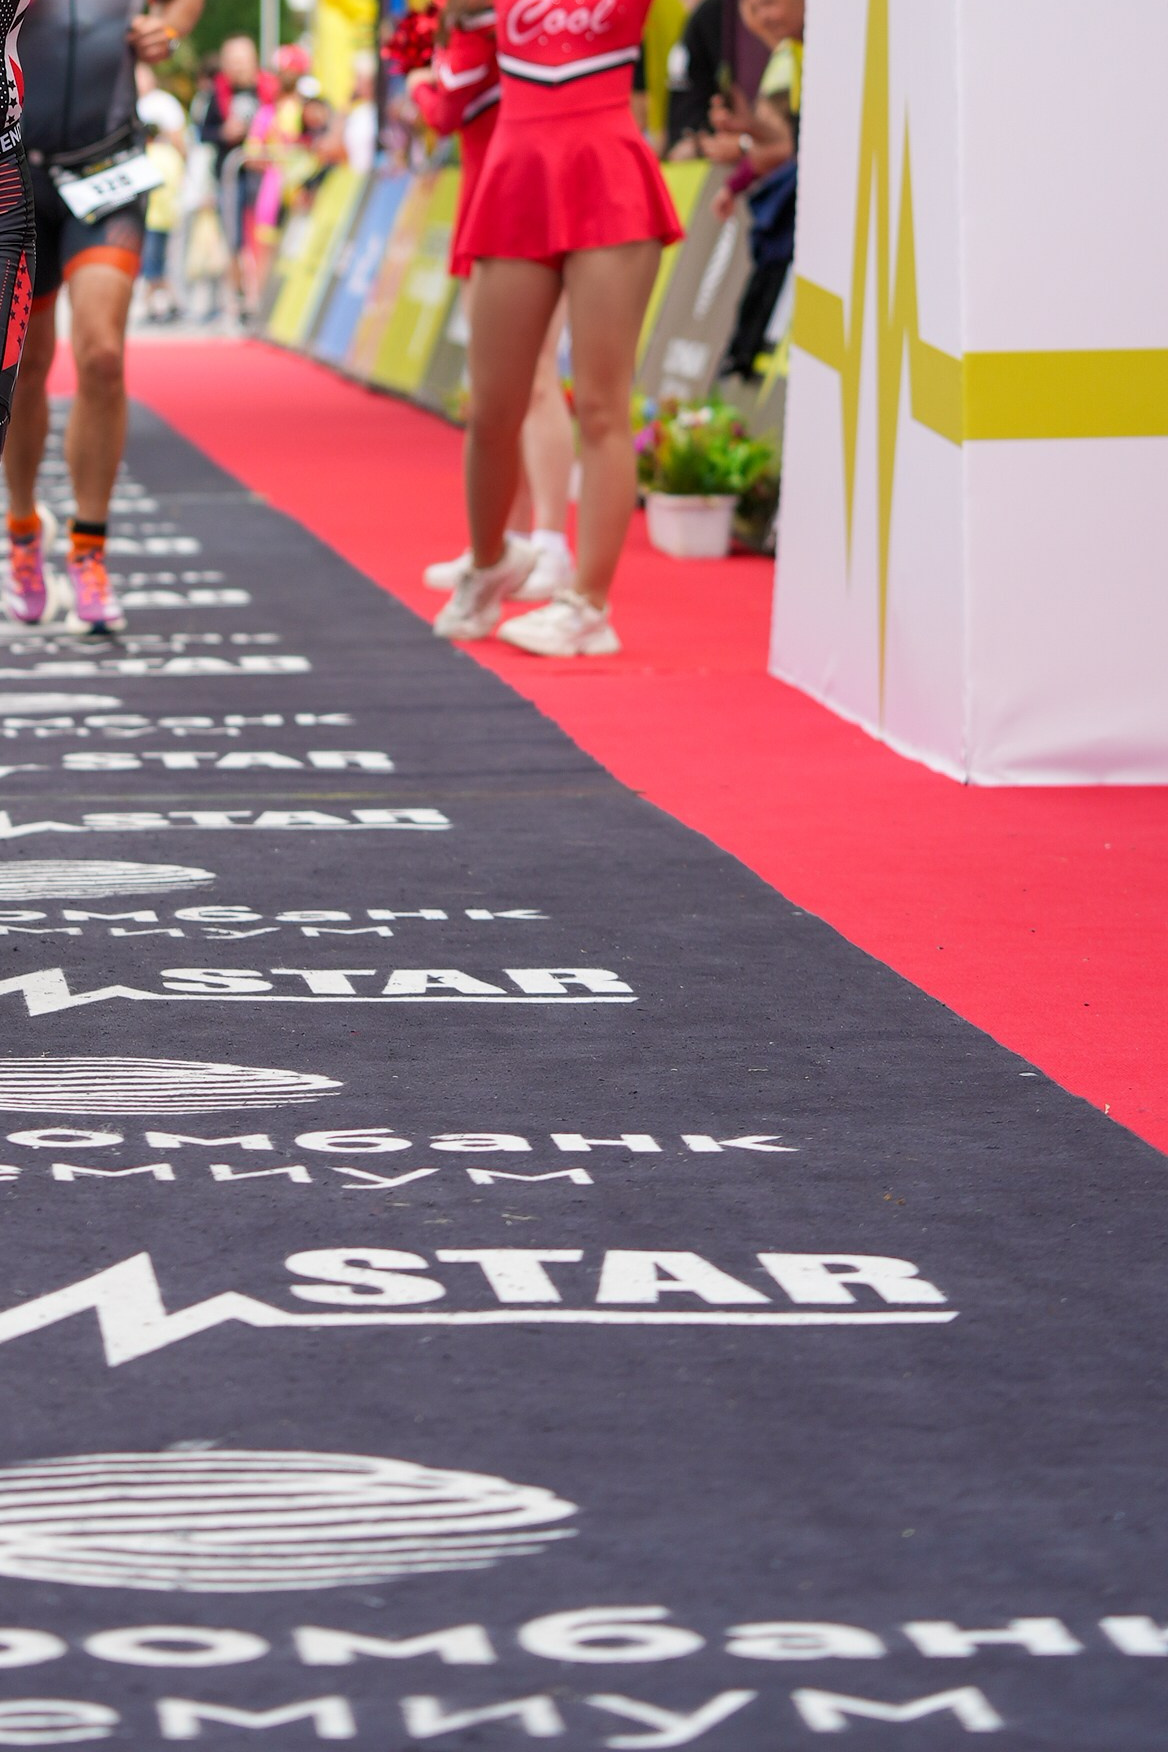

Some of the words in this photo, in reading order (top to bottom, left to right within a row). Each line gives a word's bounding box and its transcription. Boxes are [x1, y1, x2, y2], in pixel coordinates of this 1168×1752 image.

[63, 751, 394, 772] STAR
[82, 808, 450, 828] STAR
[159, 968, 633, 995] STAR
[284, 1247, 948, 1305] STAR
